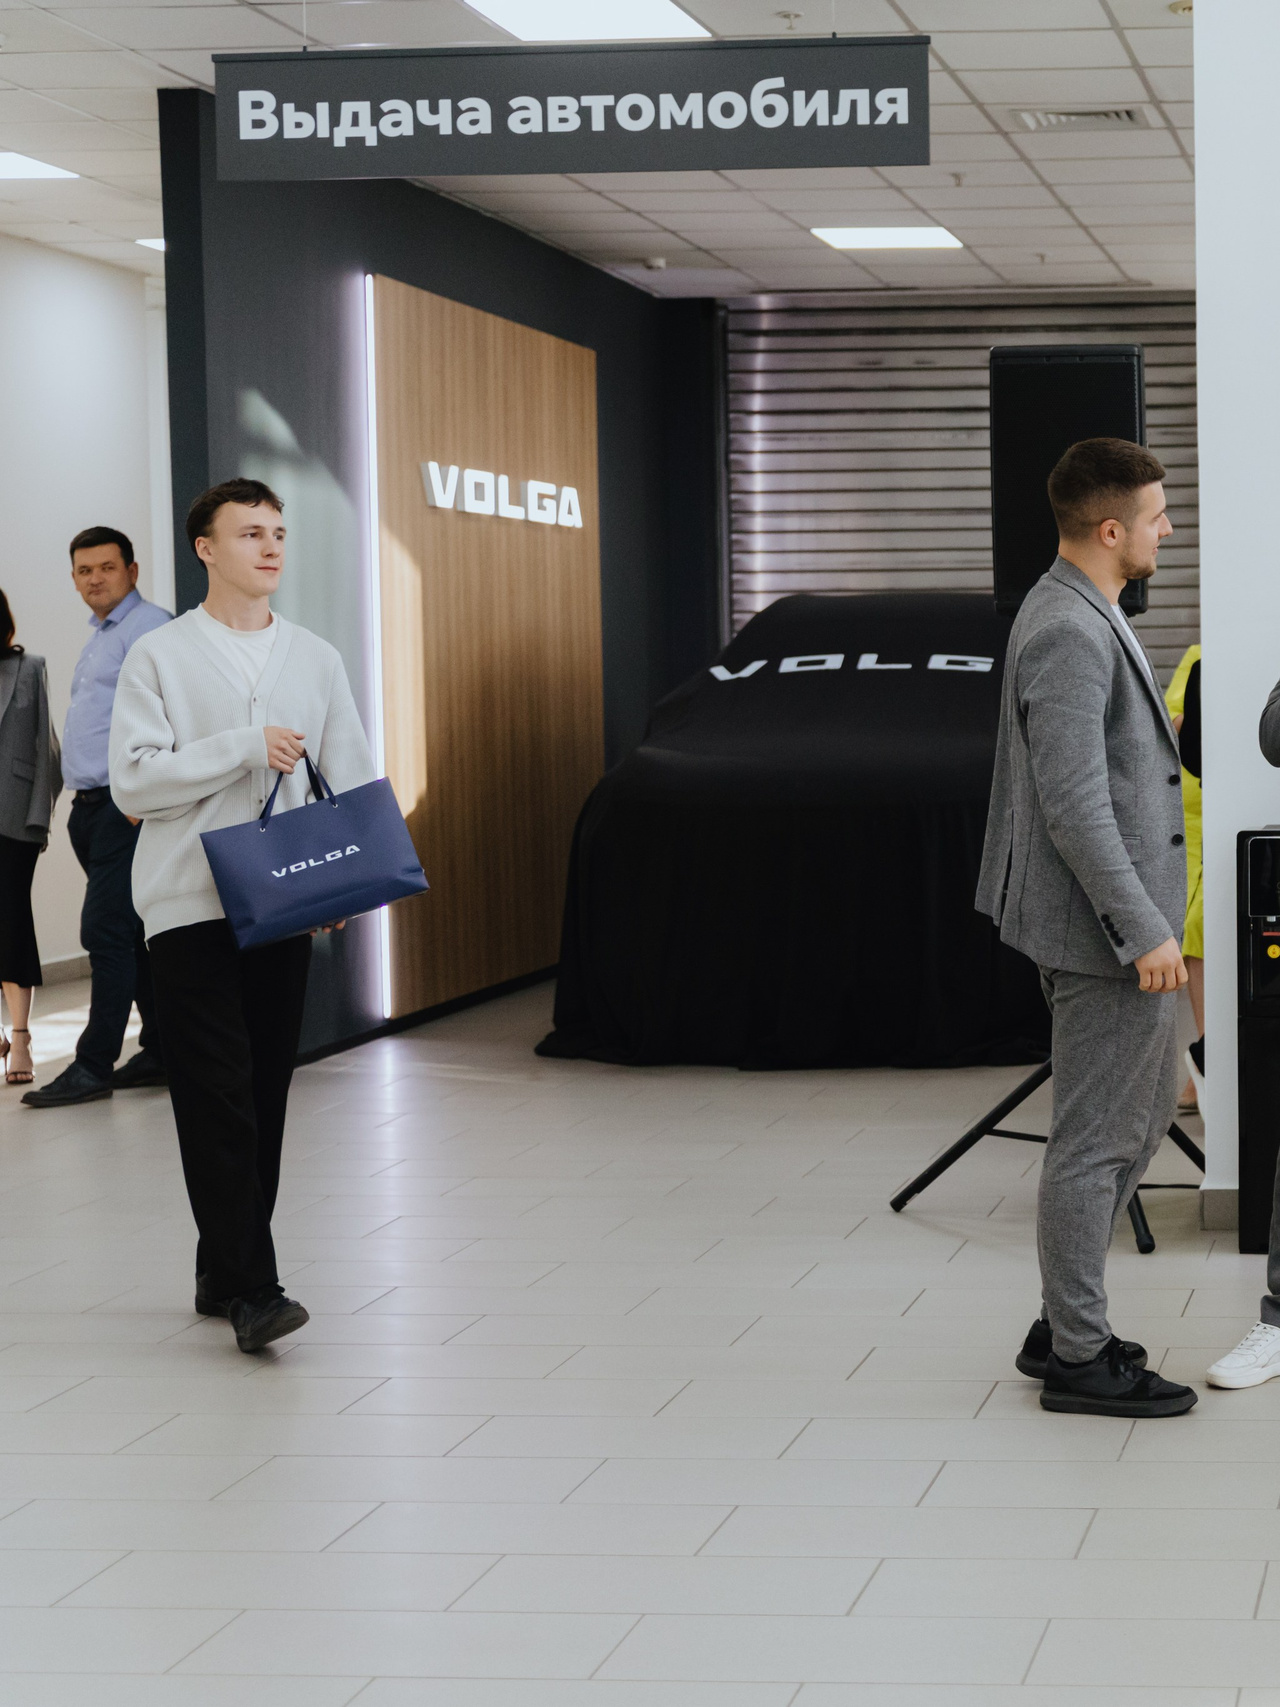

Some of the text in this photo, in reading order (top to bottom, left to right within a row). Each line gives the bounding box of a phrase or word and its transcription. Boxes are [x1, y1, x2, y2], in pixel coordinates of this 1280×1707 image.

[237, 76, 909, 147] Выдача автомобиля
[425, 460, 583, 529] VOLGA
[709, 653, 994, 681] VOLG
[271, 844, 361, 878] VOLGA
